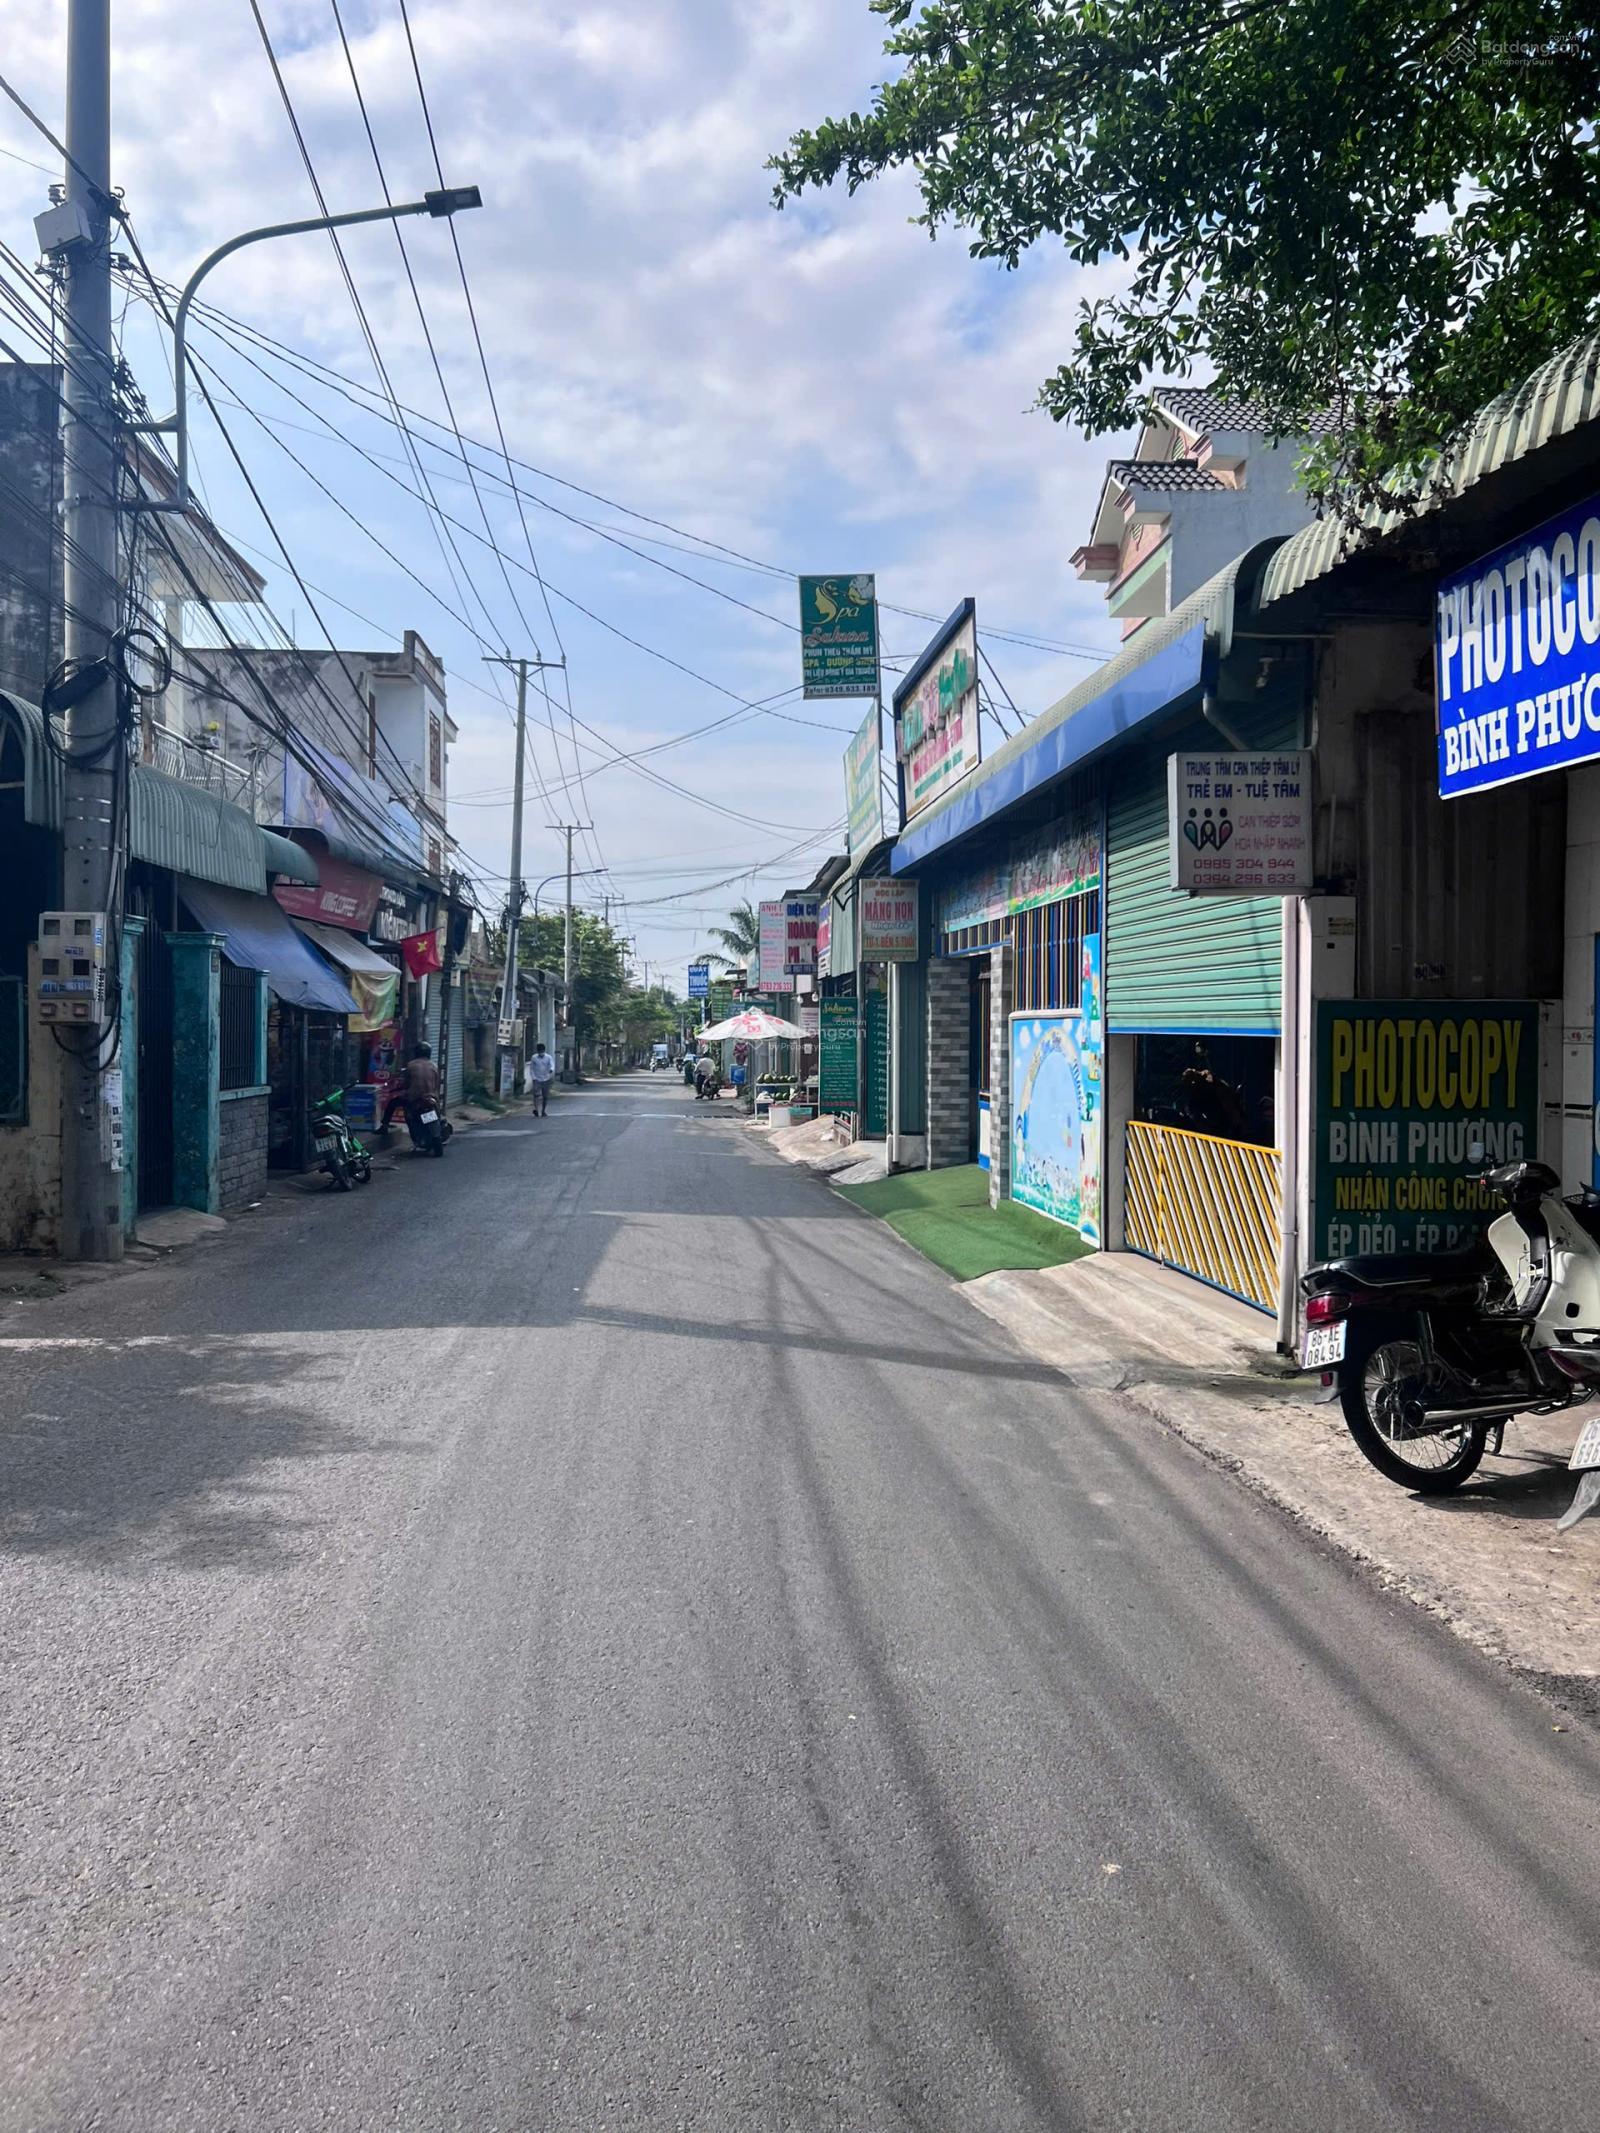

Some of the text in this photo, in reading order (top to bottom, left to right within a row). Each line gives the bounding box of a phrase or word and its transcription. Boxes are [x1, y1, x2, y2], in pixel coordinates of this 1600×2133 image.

[1444, 707, 1510, 777] BÌNH
[1186, 761, 1211, 776] TRUNG
[1215, 757, 1231, 776] TÂM
[1233, 761, 1249, 776] CAN
[1273, 757, 1290, 776] TÂM
[1186, 778, 1211, 798] TRẺ
[1214, 784, 1233, 798] EM
[1245, 779, 1269, 802] TUỆ
[1273, 779, 1301, 798] TÂM
[1238, 815, 1257, 829] CAN
[895, 901, 913, 921] NON
[1331, 1018, 1523, 1110] PHOTOCOPY
[1329, 1112, 1524, 1164] BÌNH PHƯƠNG
[1335, 1171, 1389, 1218] NHẬN
[1395, 1170, 1446, 1211] CÔNG
[1328, 1217, 1352, 1258] ÉP
[1416, 1217, 1440, 1253] ÉP
[1311, 1324, 1341, 1348] 86-AE
[1307, 1342, 1342, 1366] 084.94
